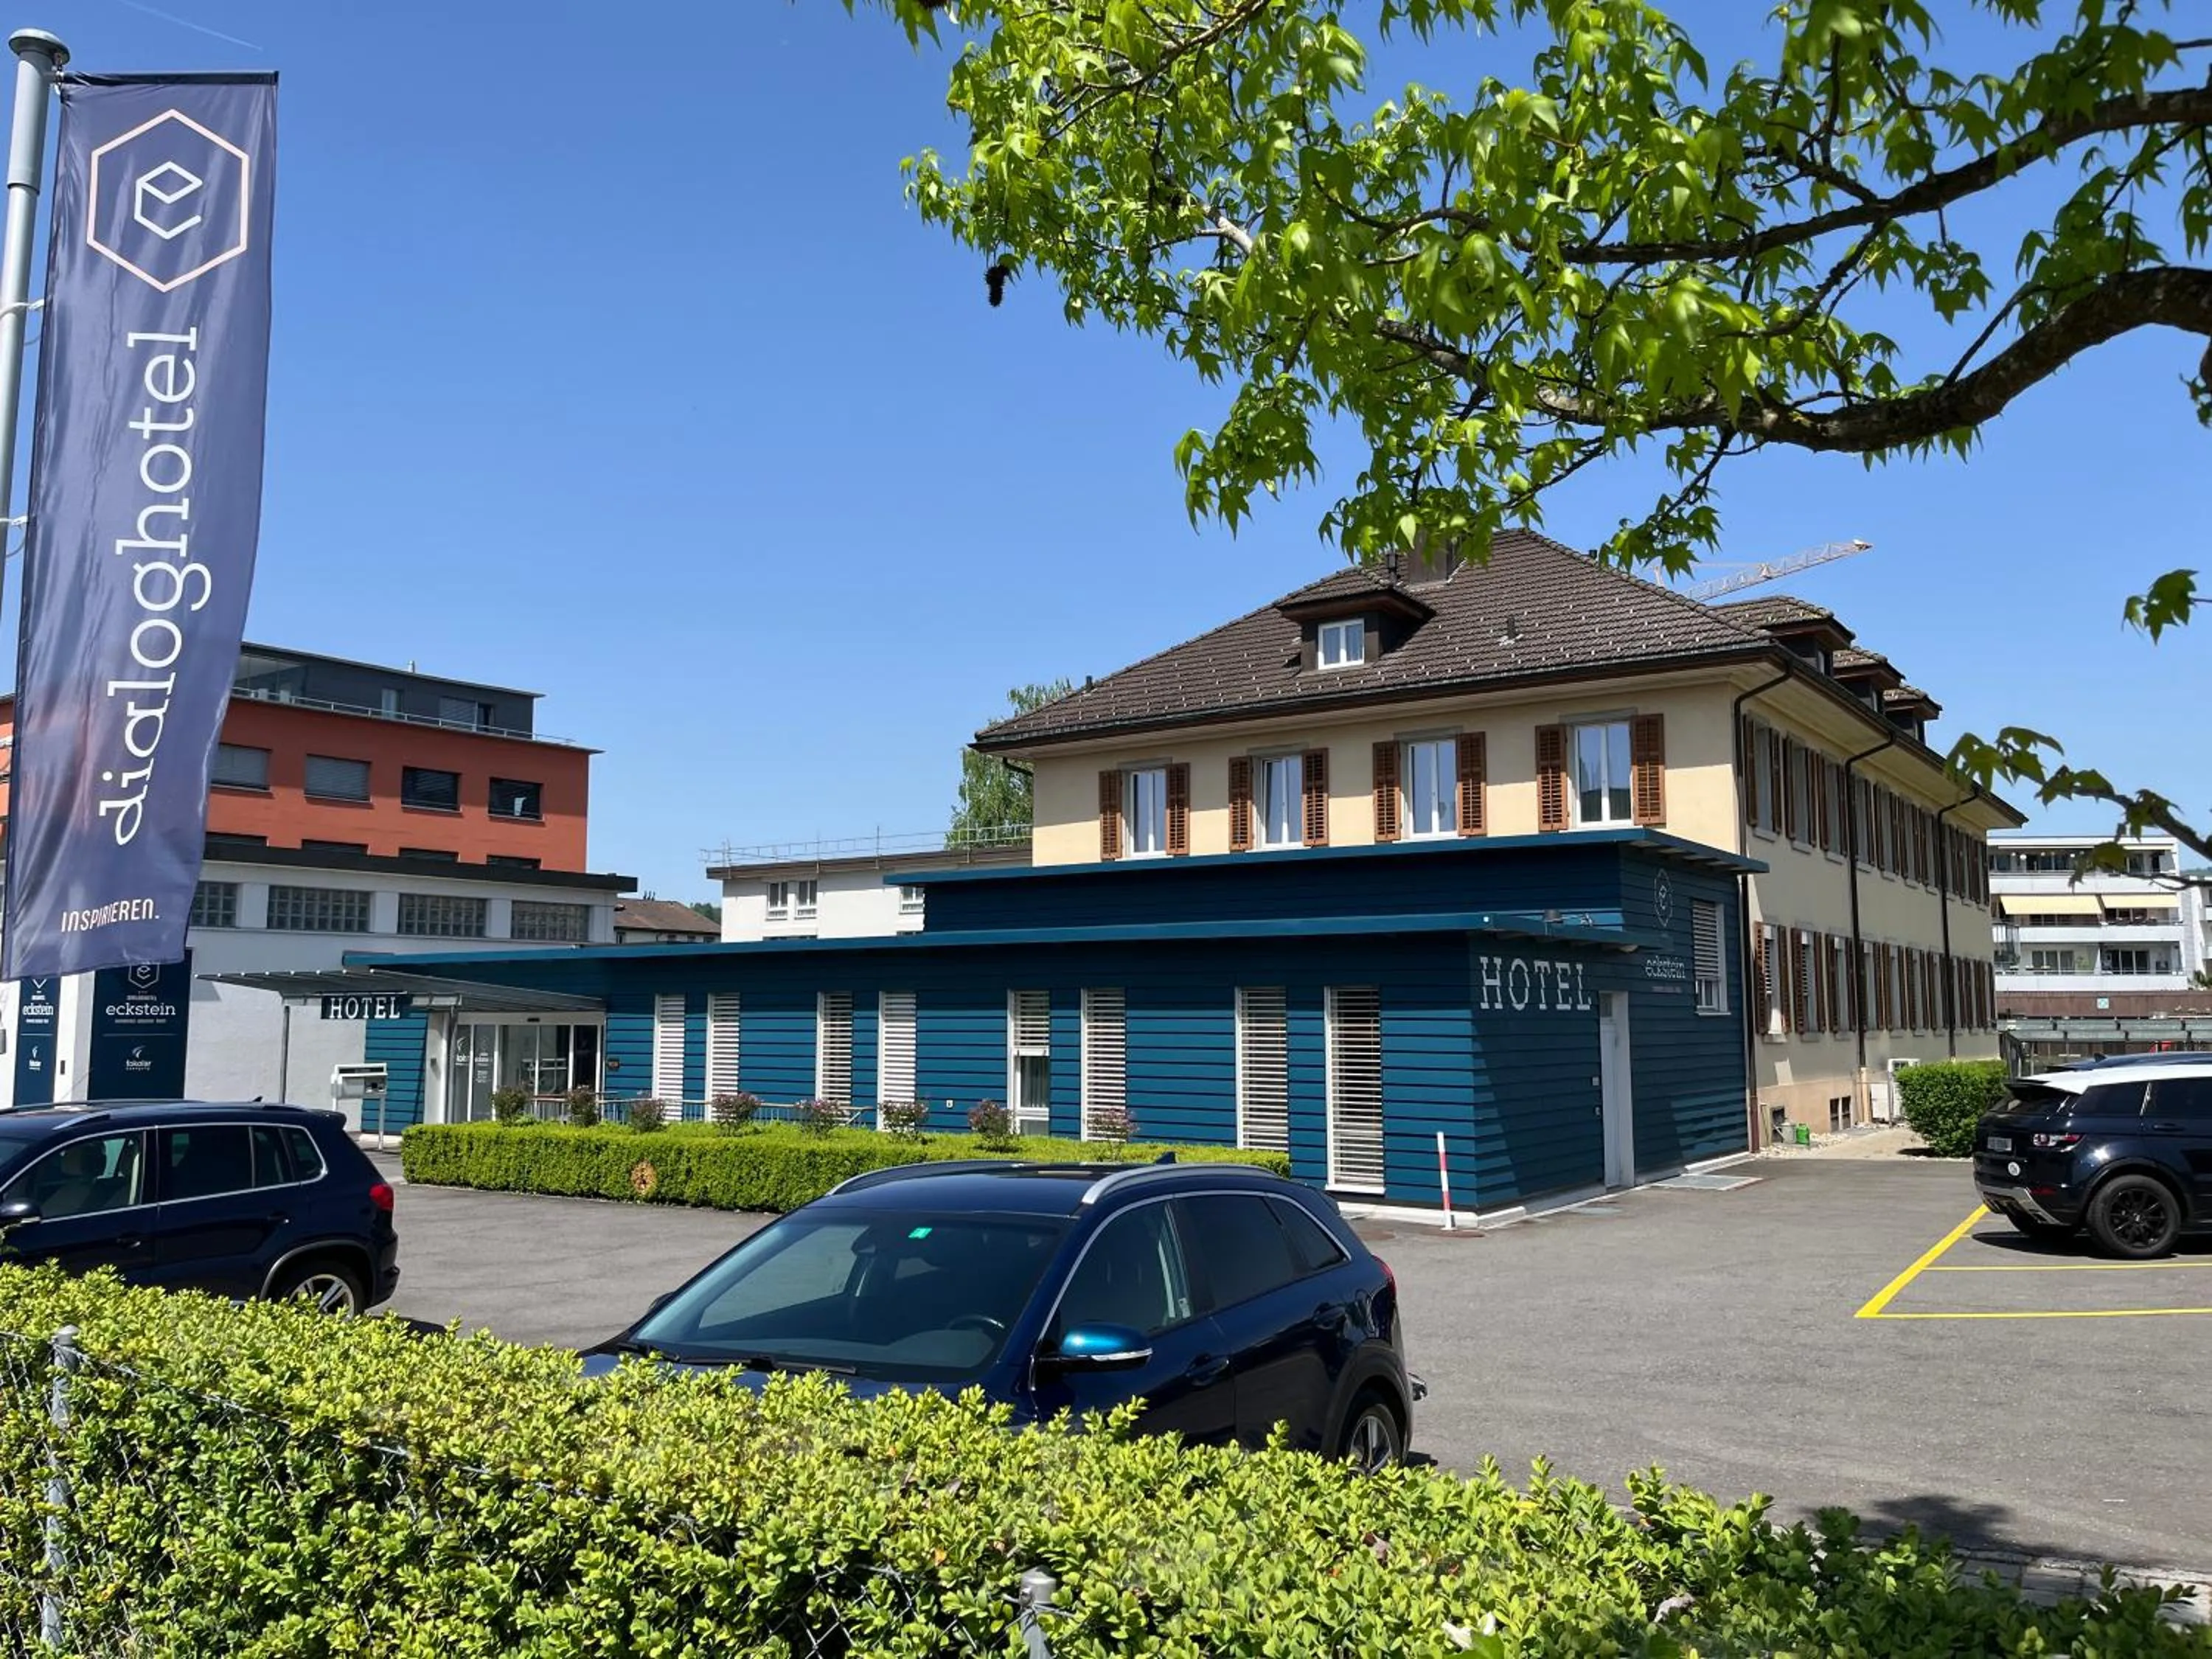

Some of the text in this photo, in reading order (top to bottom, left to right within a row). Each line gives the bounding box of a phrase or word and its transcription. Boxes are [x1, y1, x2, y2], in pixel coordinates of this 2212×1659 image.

[98, 327, 212, 846] dialoghotel
[1646, 956, 1686, 978] eckstein
[1480, 957, 1592, 1010] HOTEL
[22, 1002, 54, 1015] eckstein
[105, 1002, 176, 1015] eckstein
[329, 997, 400, 1019] HOTEL
